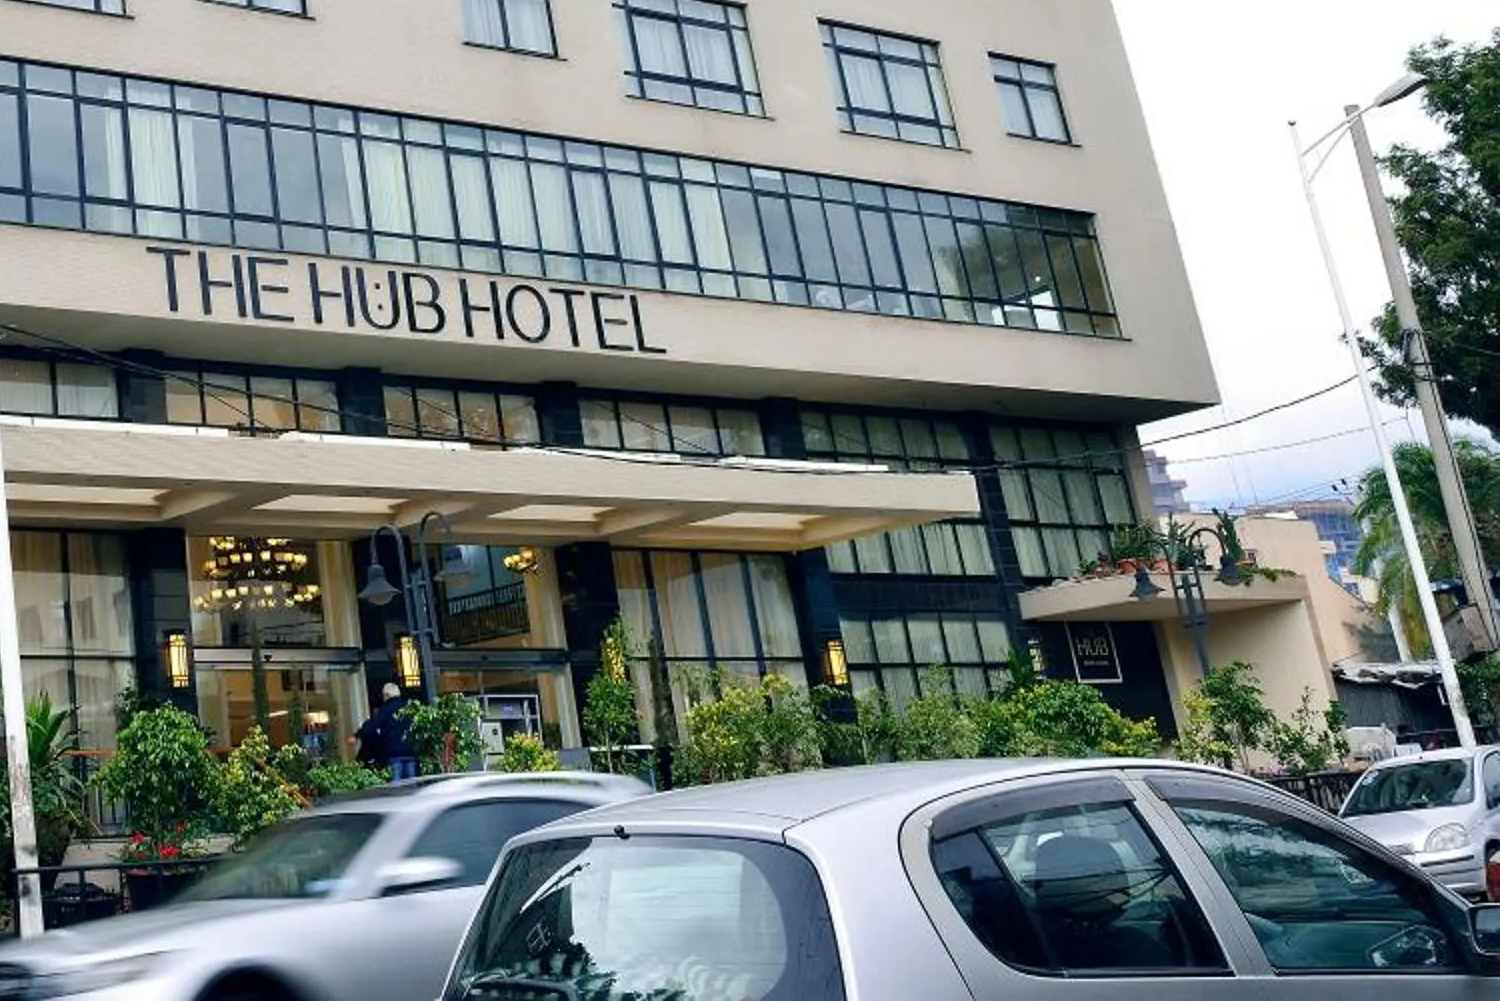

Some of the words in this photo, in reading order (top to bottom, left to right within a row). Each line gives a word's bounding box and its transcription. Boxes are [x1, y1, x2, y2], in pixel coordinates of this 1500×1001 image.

[146, 246, 295, 322] THE
[308, 261, 446, 334] HUB
[459, 278, 668, 354] HOTEL
